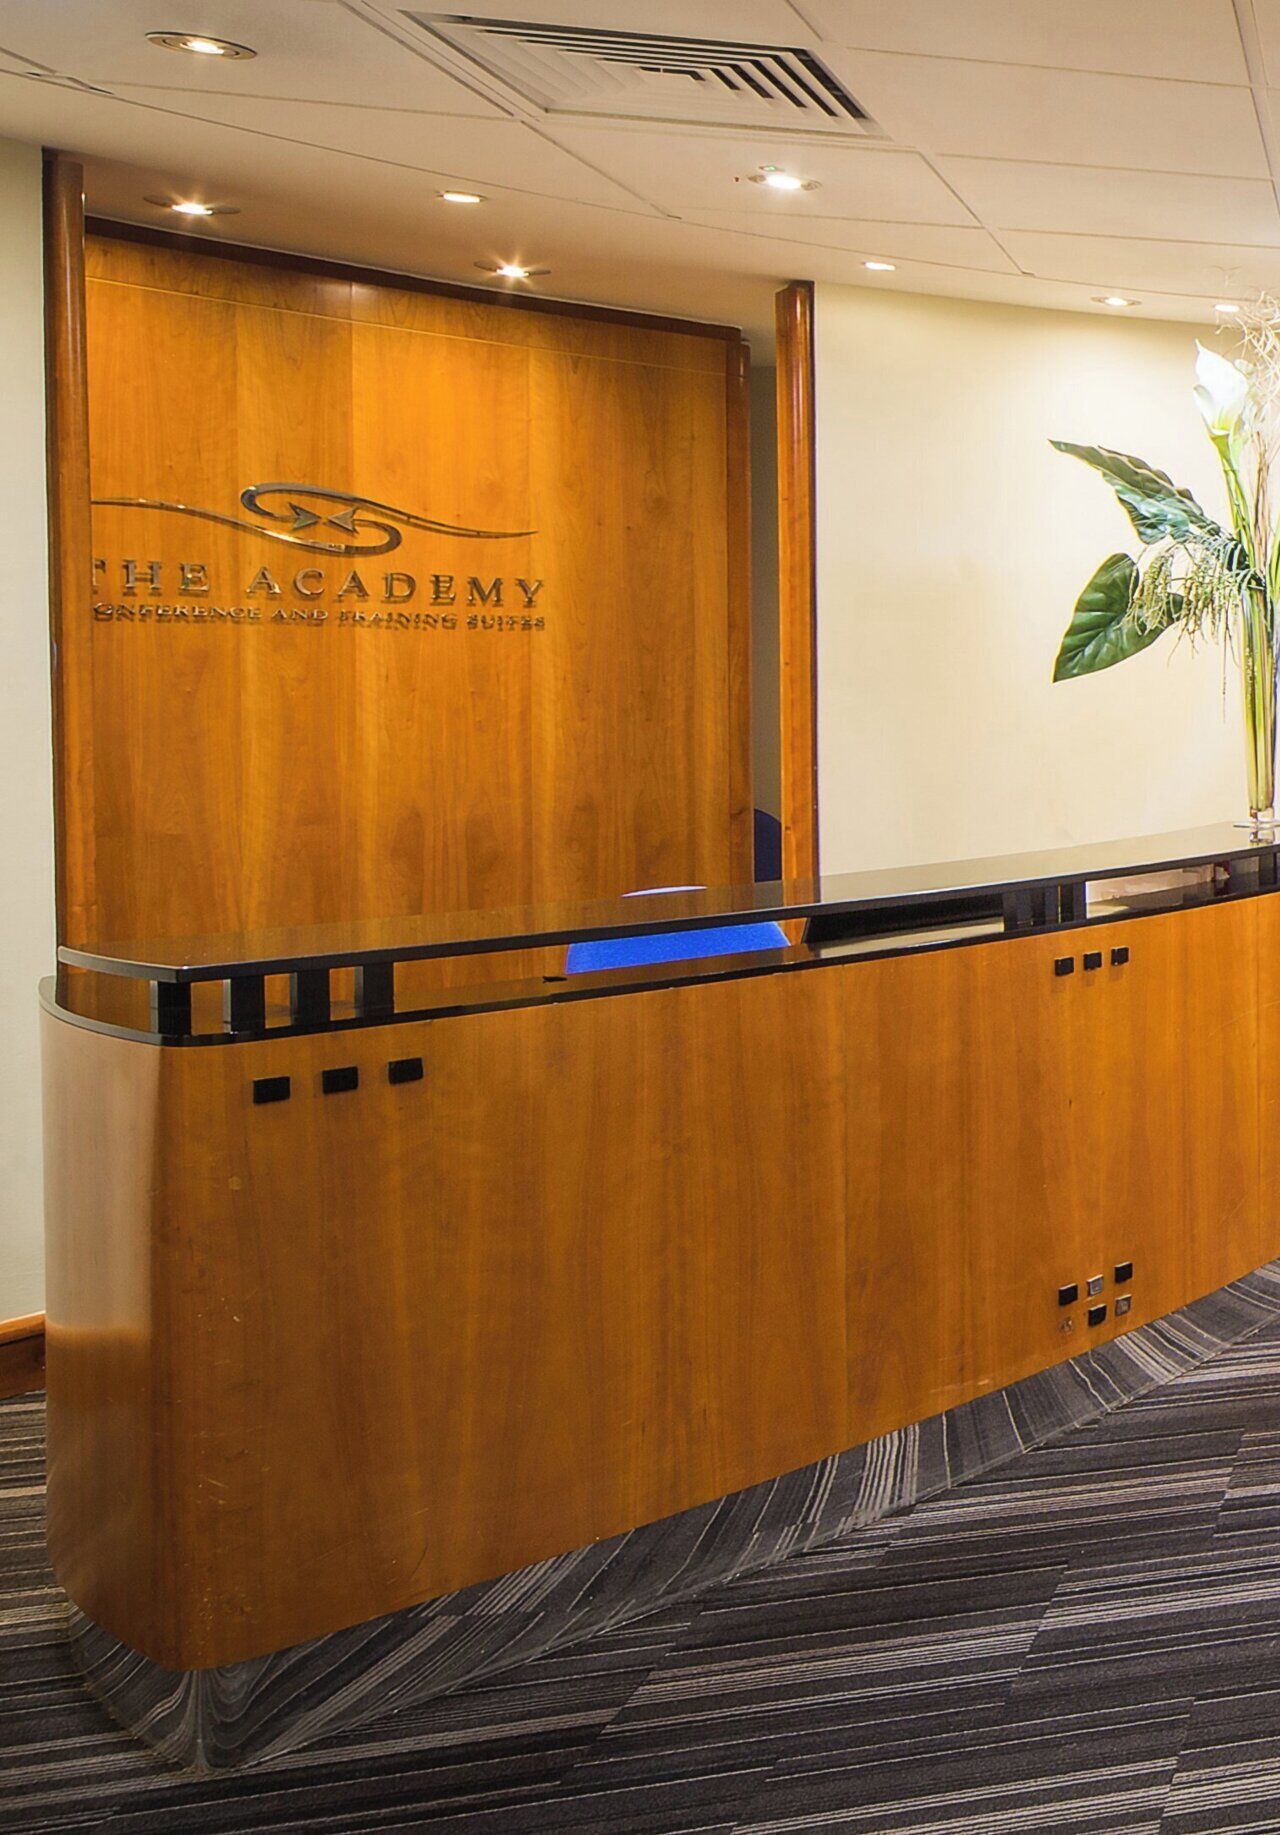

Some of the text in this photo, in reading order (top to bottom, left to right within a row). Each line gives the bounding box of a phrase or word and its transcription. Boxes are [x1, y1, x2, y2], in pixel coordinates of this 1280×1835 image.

[245, 566, 544, 606] ACADEMY
[93, 602, 546, 630] ONFERENCE AND TRAINING SUITES
